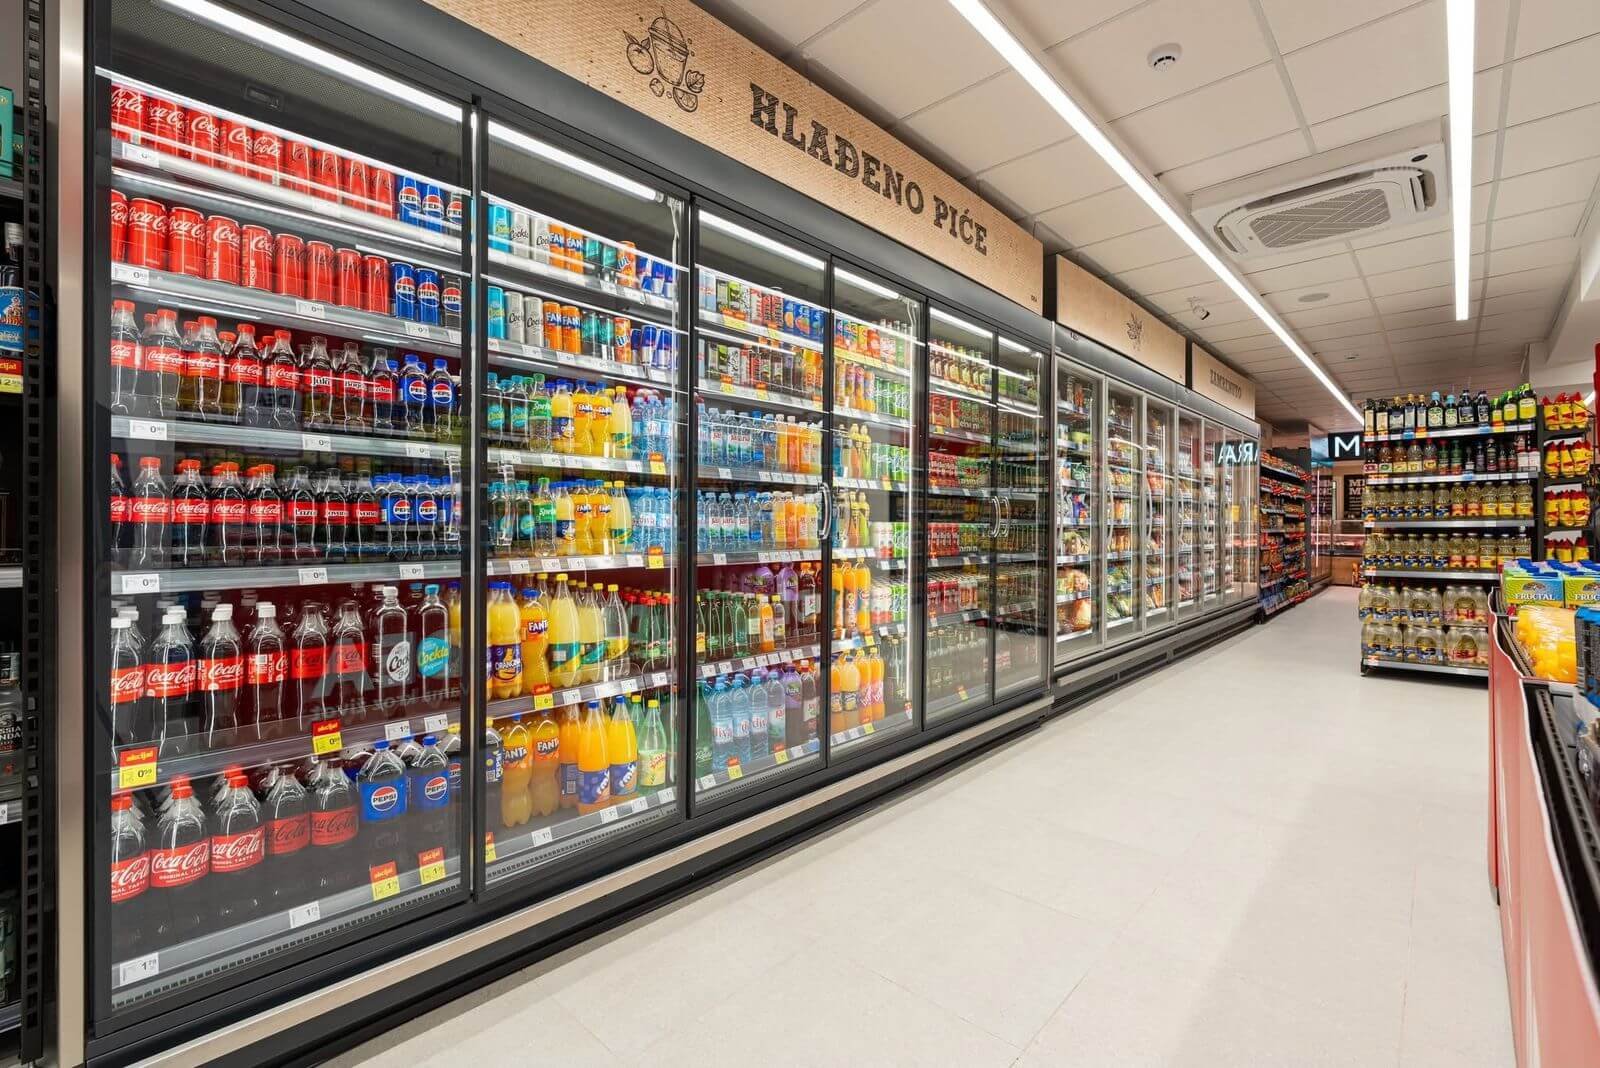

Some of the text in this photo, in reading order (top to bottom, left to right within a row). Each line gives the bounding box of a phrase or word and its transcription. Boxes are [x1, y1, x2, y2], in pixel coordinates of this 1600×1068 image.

[750, 82, 988, 256] HLAĐENO PIĆE
[1514, 593, 1556, 601] FRUCTAL
[372, 793, 397, 803] PEPSI
[151, 842, 209, 875] Coca-Cola
